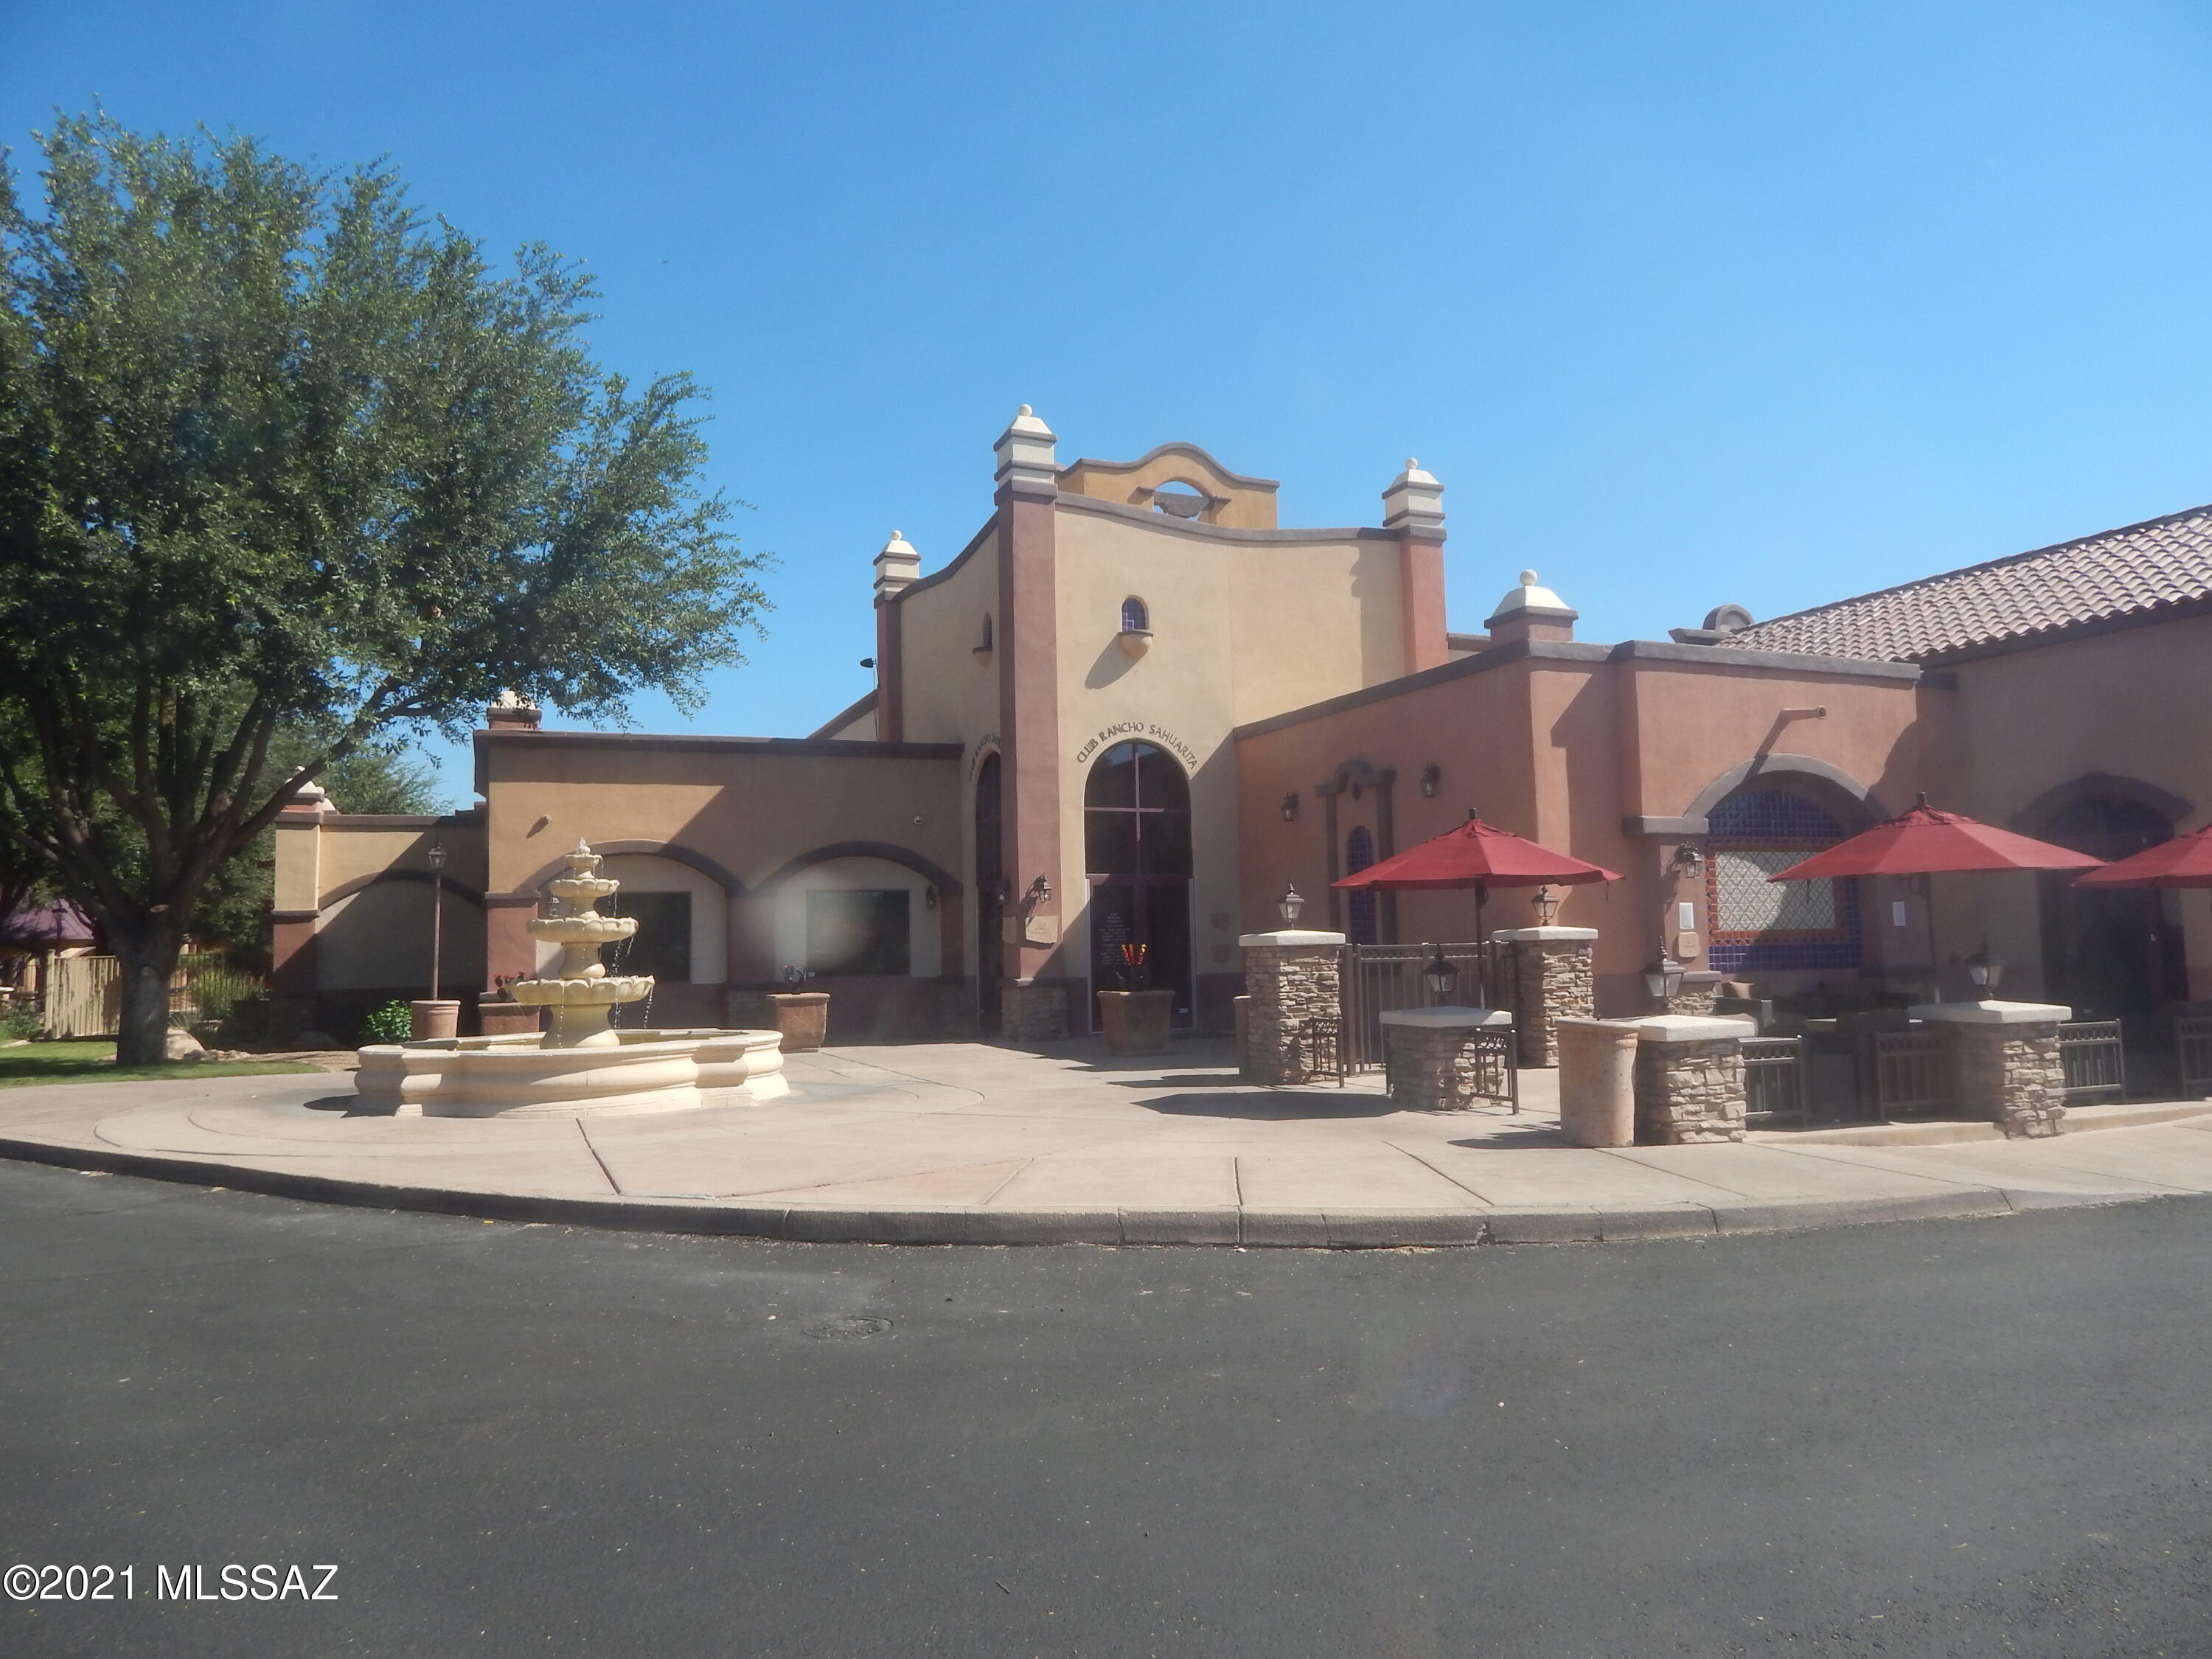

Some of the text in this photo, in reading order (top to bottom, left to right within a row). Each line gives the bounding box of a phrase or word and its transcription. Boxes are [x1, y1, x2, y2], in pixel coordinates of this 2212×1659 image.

[1077, 722, 1197, 770] CLUB RANCHO SAHUARITA
